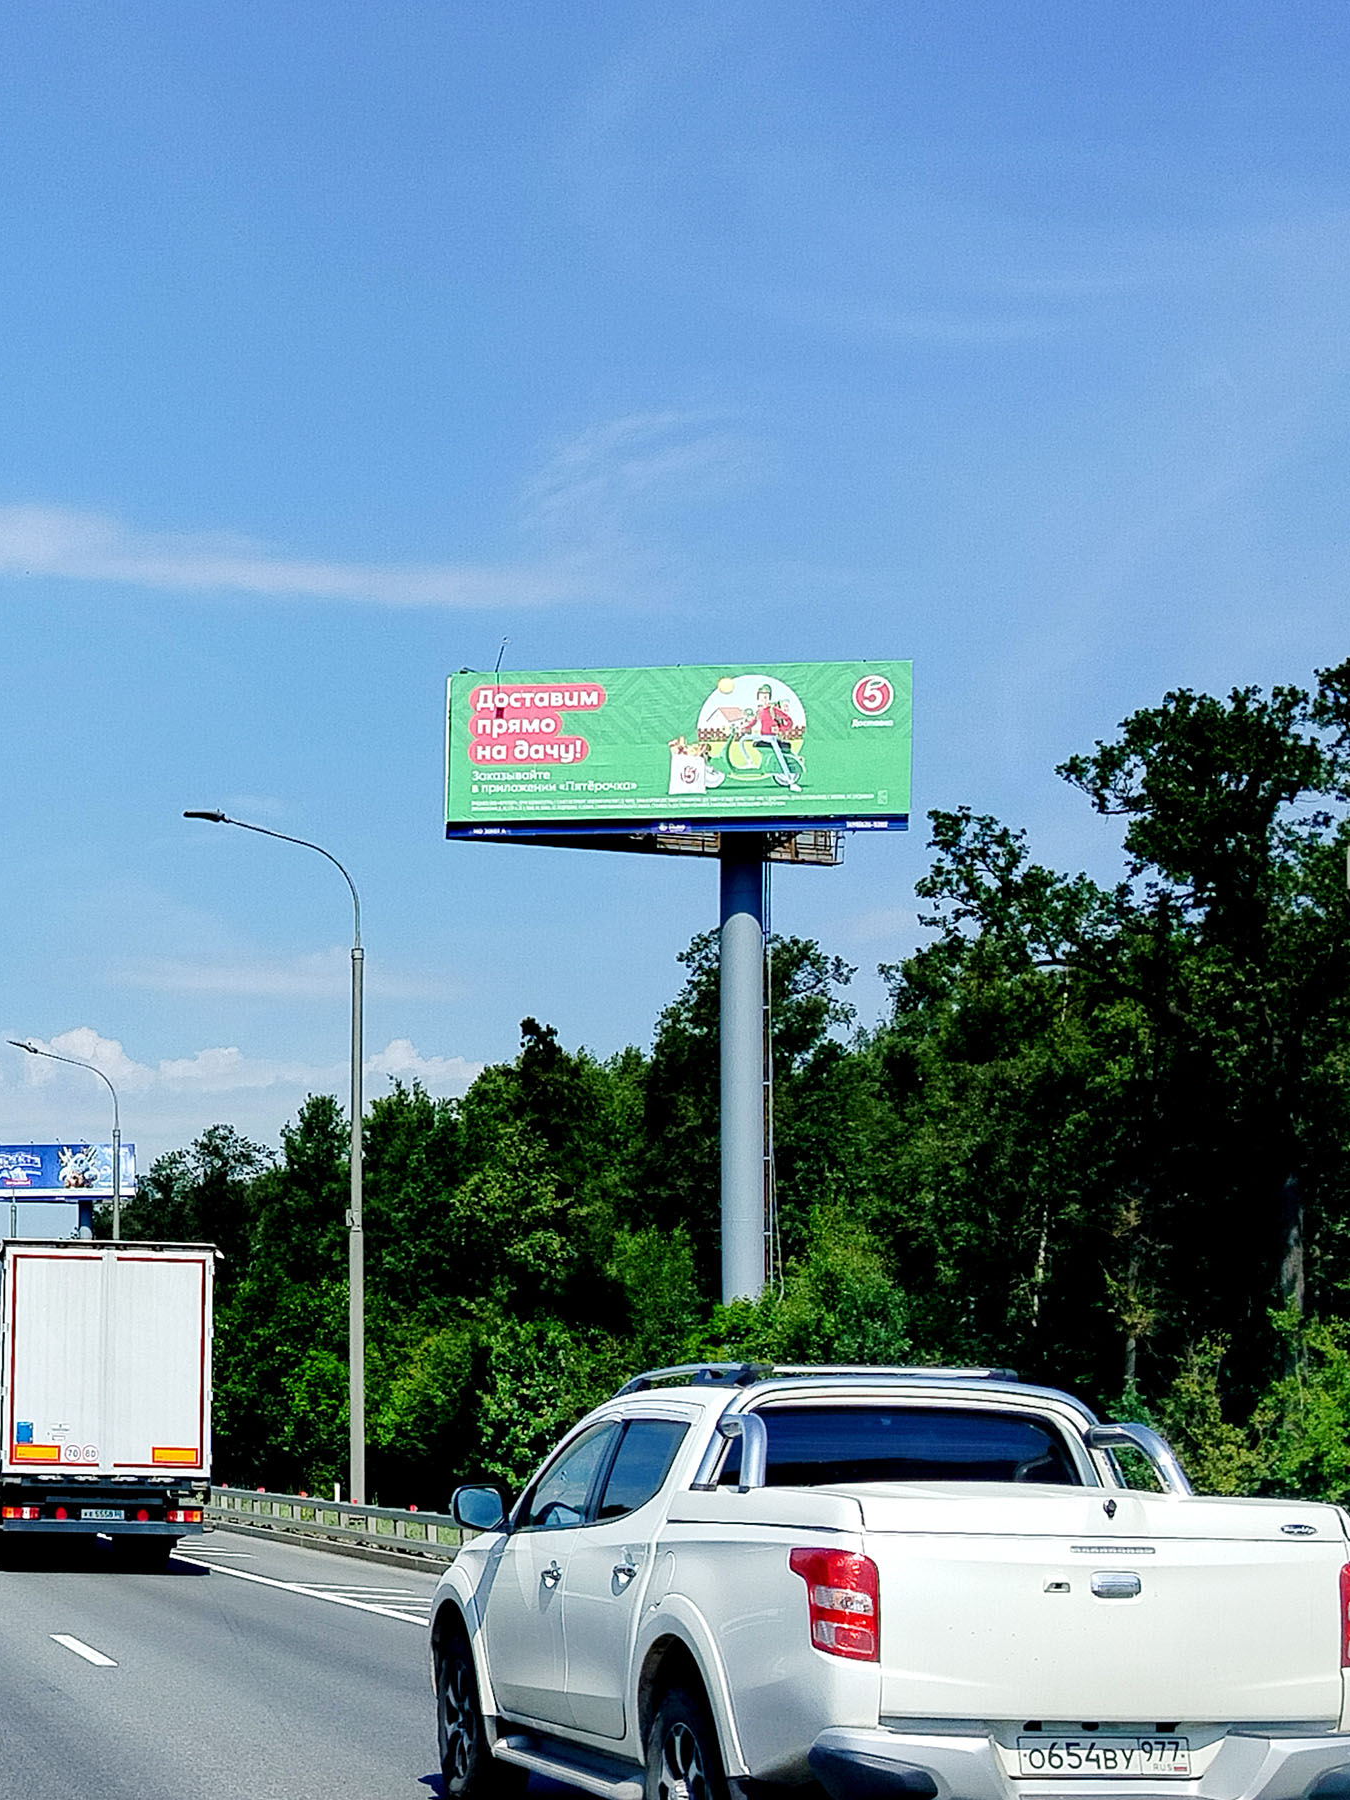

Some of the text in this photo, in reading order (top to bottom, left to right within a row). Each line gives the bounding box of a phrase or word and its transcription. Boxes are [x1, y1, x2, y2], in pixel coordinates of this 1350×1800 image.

[476, 689, 599, 712] Доставим
[477, 718, 556, 738] прямо
[476, 739, 582, 763] на дачу!
[471, 770, 551, 781] Заказывайте
[471, 780, 638, 795] в приложении «Пятёрочка»
[68, 1449, 79, 1458] 70
[1028, 1740, 1180, 1770] О654ВУ 977
[1153, 1762, 1173, 1771] RUS
